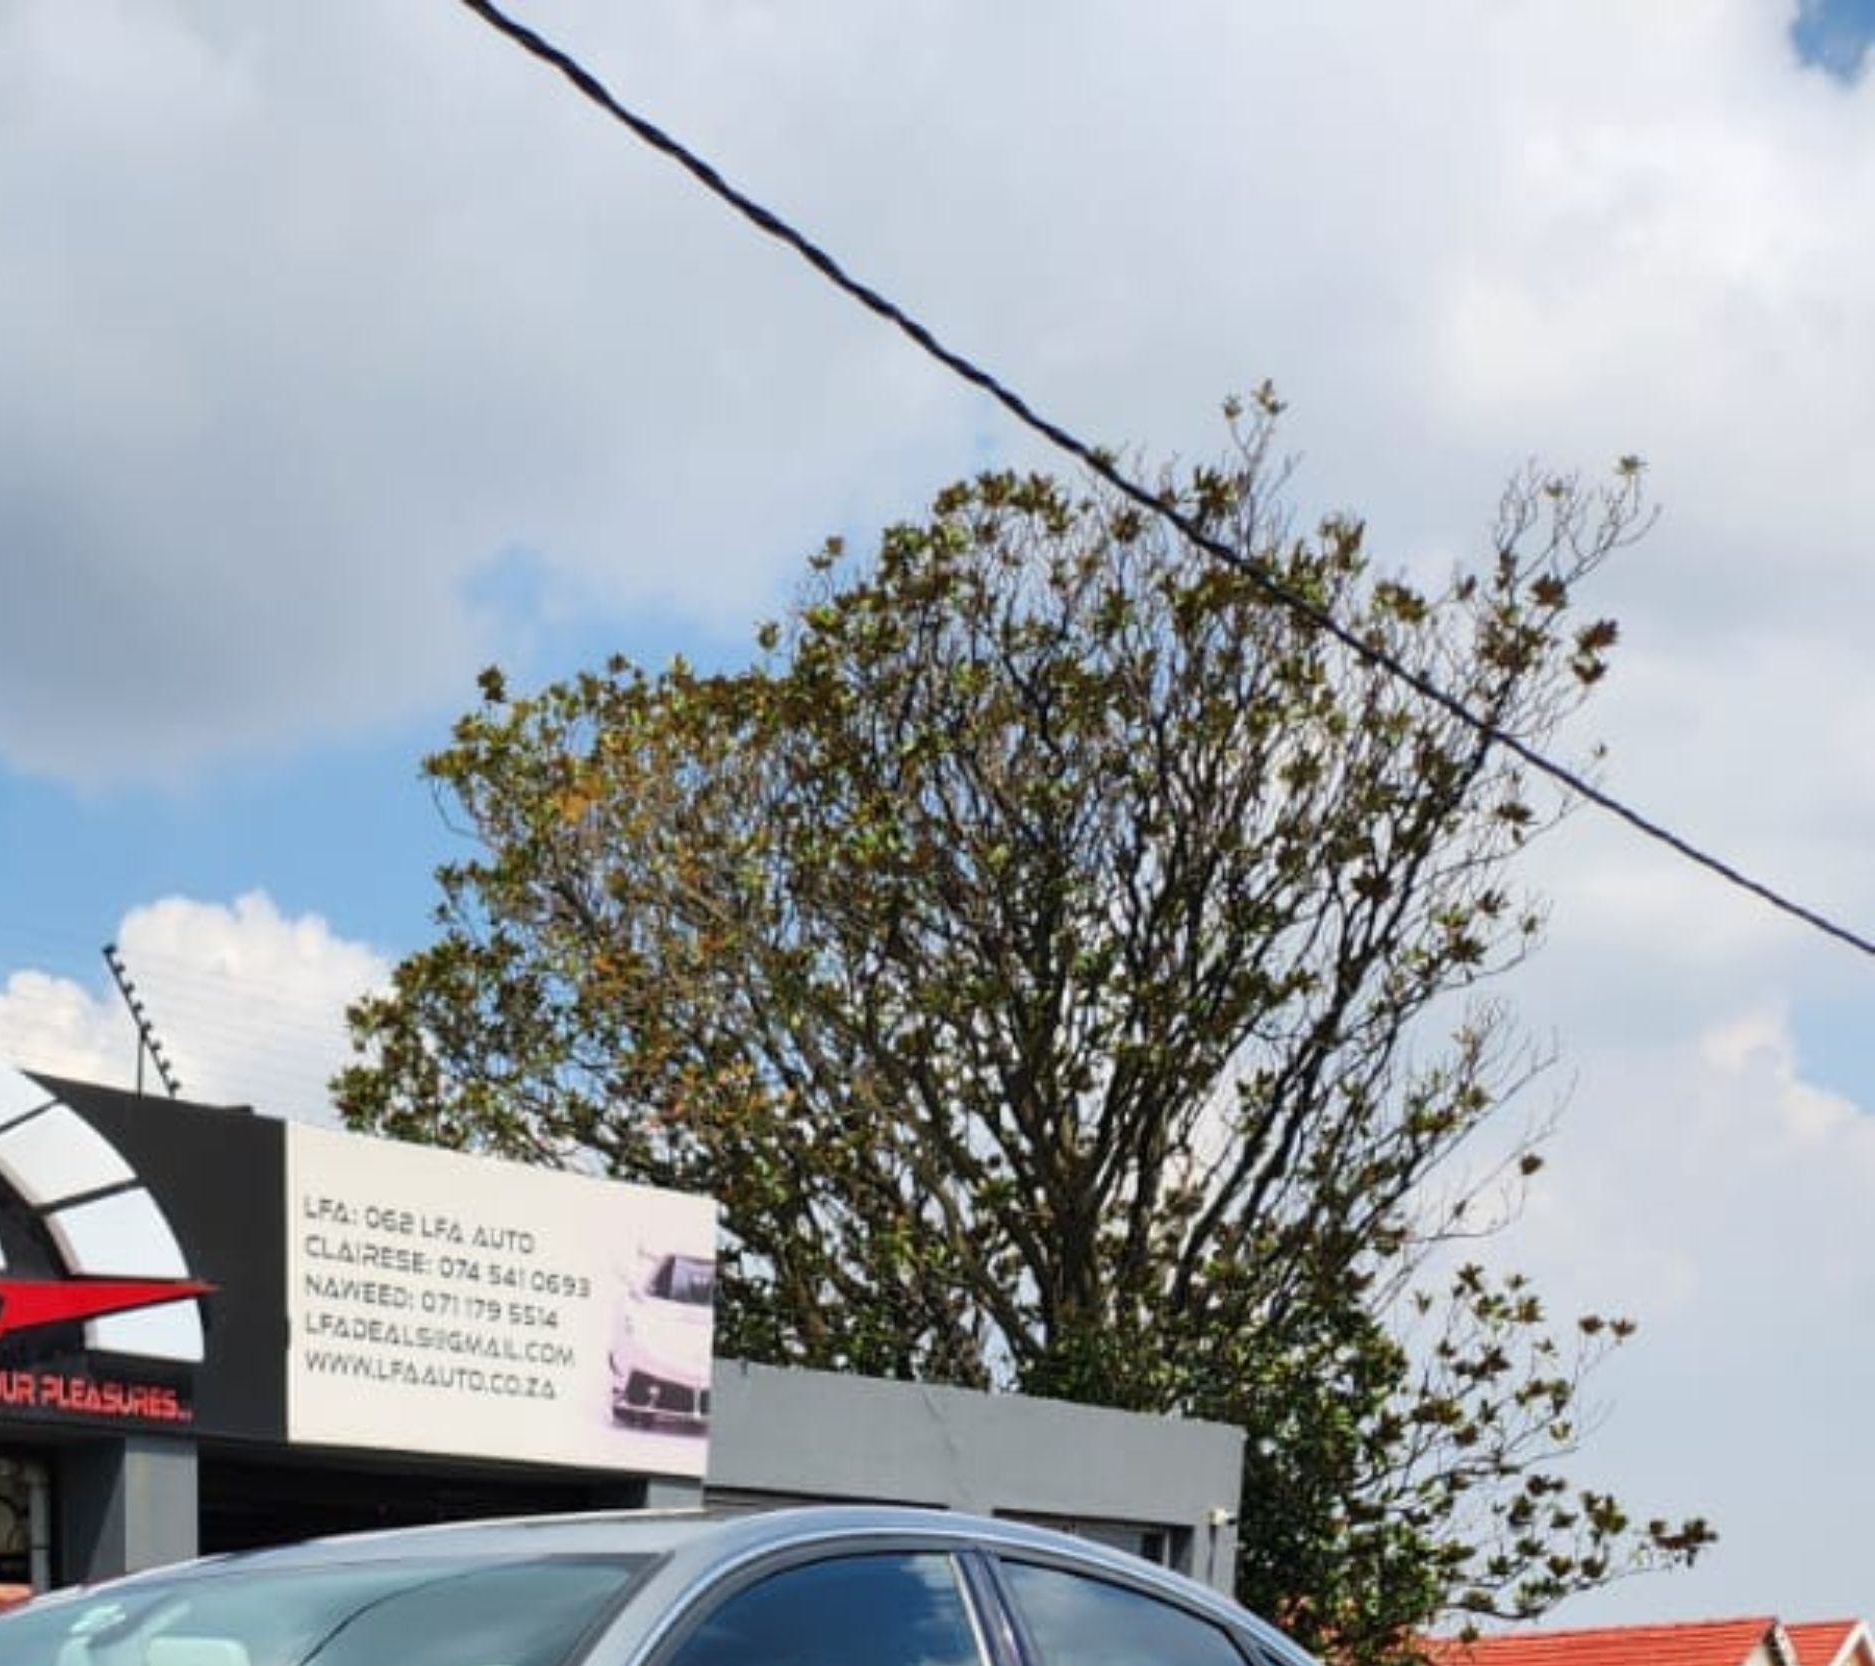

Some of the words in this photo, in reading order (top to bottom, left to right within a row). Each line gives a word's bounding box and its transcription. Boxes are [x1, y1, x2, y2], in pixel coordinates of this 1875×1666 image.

[303, 1195, 359, 1226] LFA:
[365, 1205, 414, 1236] 062
[421, 1214, 464, 1244] LFA
[472, 1224, 536, 1254] AUTO
[440, 1255, 481, 1282] 074
[488, 1263, 526, 1288] 541
[531, 1269, 591, 1298] 0693
[304, 1350, 557, 1400] WWW.LFAAUTO.CO.ZA
